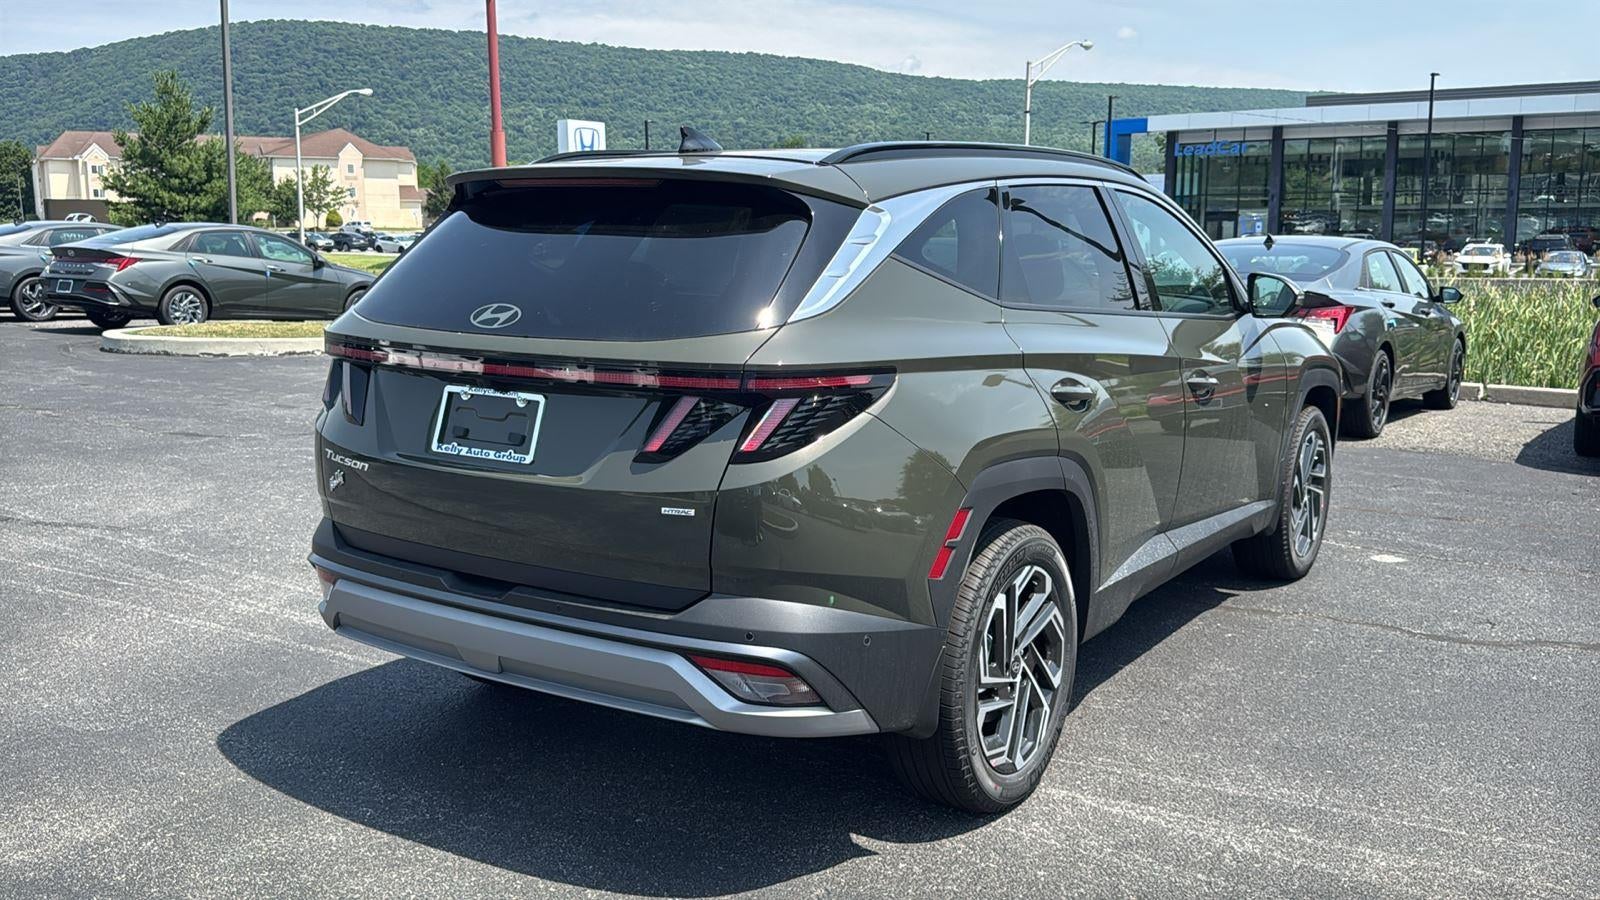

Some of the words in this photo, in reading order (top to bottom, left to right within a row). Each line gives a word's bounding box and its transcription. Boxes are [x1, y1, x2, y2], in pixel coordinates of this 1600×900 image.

[1174, 140, 1247, 157] LeadCar
[325, 448, 369, 471] Tucson
[436, 443, 463, 457] Kelly
[465, 447, 491, 458] Auto
[494, 451, 527, 464] Group
[662, 508, 694, 516] HTRAC
